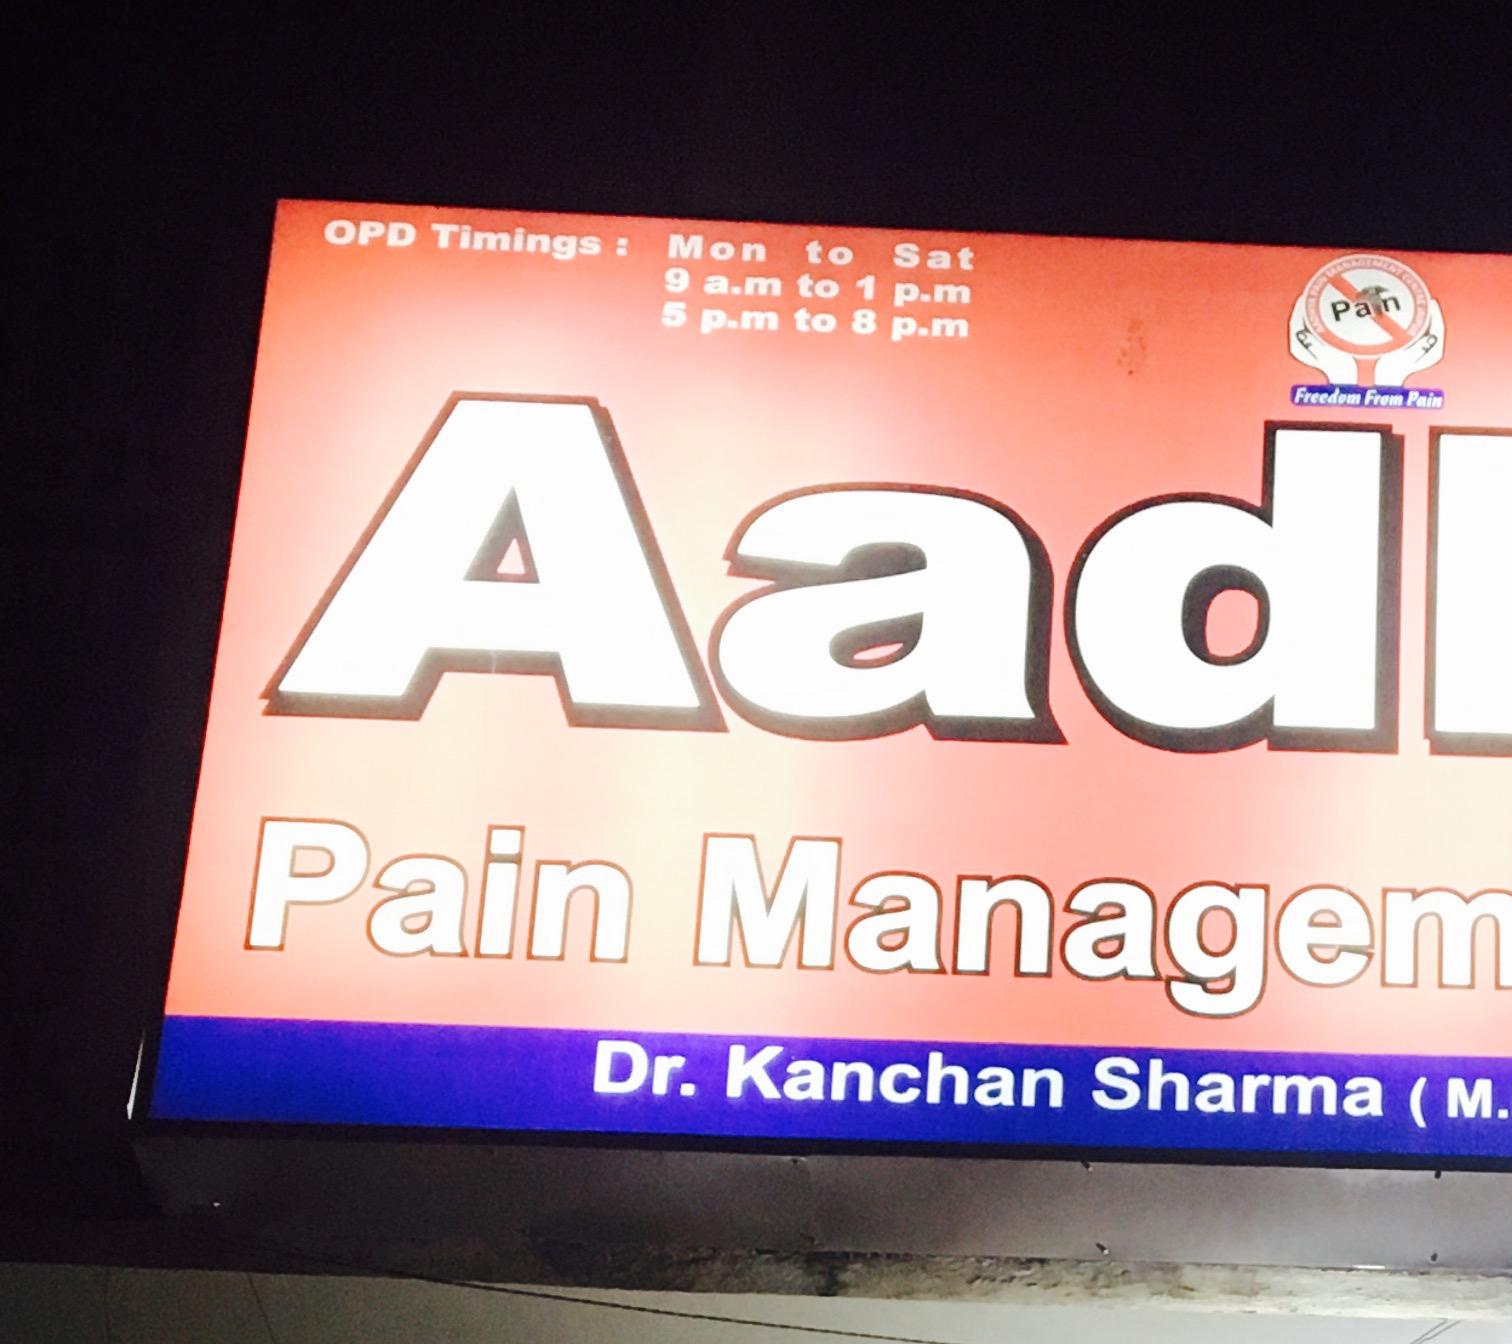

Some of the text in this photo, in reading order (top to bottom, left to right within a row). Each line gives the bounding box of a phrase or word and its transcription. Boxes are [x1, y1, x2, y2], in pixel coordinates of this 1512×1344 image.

[324, 220, 602, 259] OPD Timings
[668, 234, 974, 271] Mon to Sat
[665, 267, 971, 306] 9 a.m to 1 p.m
[661, 301, 970, 341] 5 p.m to 8 p.m
[1294, 387, 1443, 408] Freedom From Pain
[243, 815, 634, 963] Pain
[592, 1040, 697, 1097] Dr.
[723, 1044, 1064, 1108] Kanchan
[1090, 1054, 1385, 1118] Sharma
